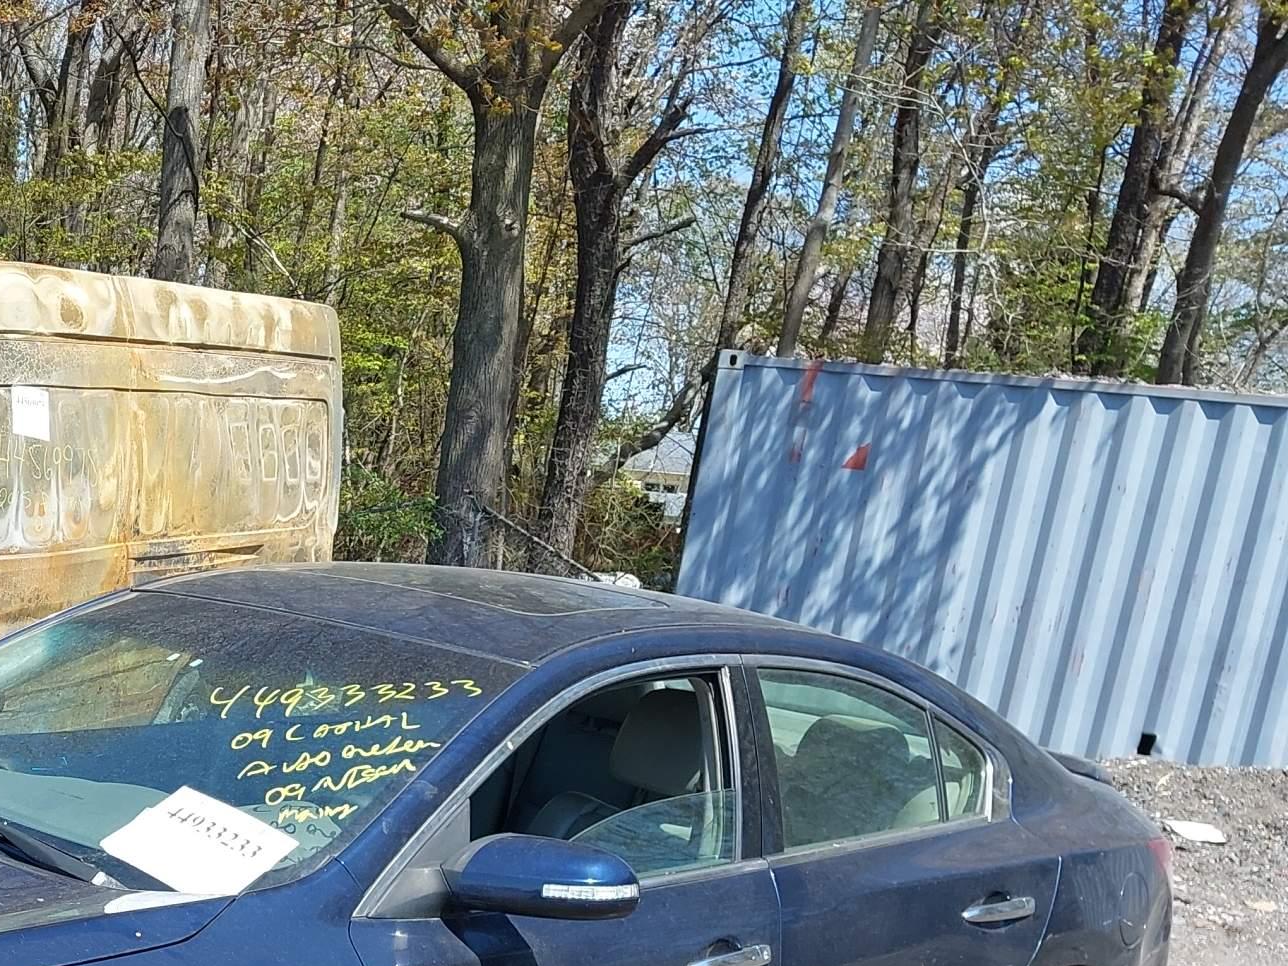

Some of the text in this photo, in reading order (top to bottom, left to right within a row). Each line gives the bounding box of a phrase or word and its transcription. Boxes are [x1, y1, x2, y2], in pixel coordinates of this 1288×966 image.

[231, 728, 273, 749] 09
[265, 784, 306, 806] 09
[167, 807, 263, 858] 44933233
